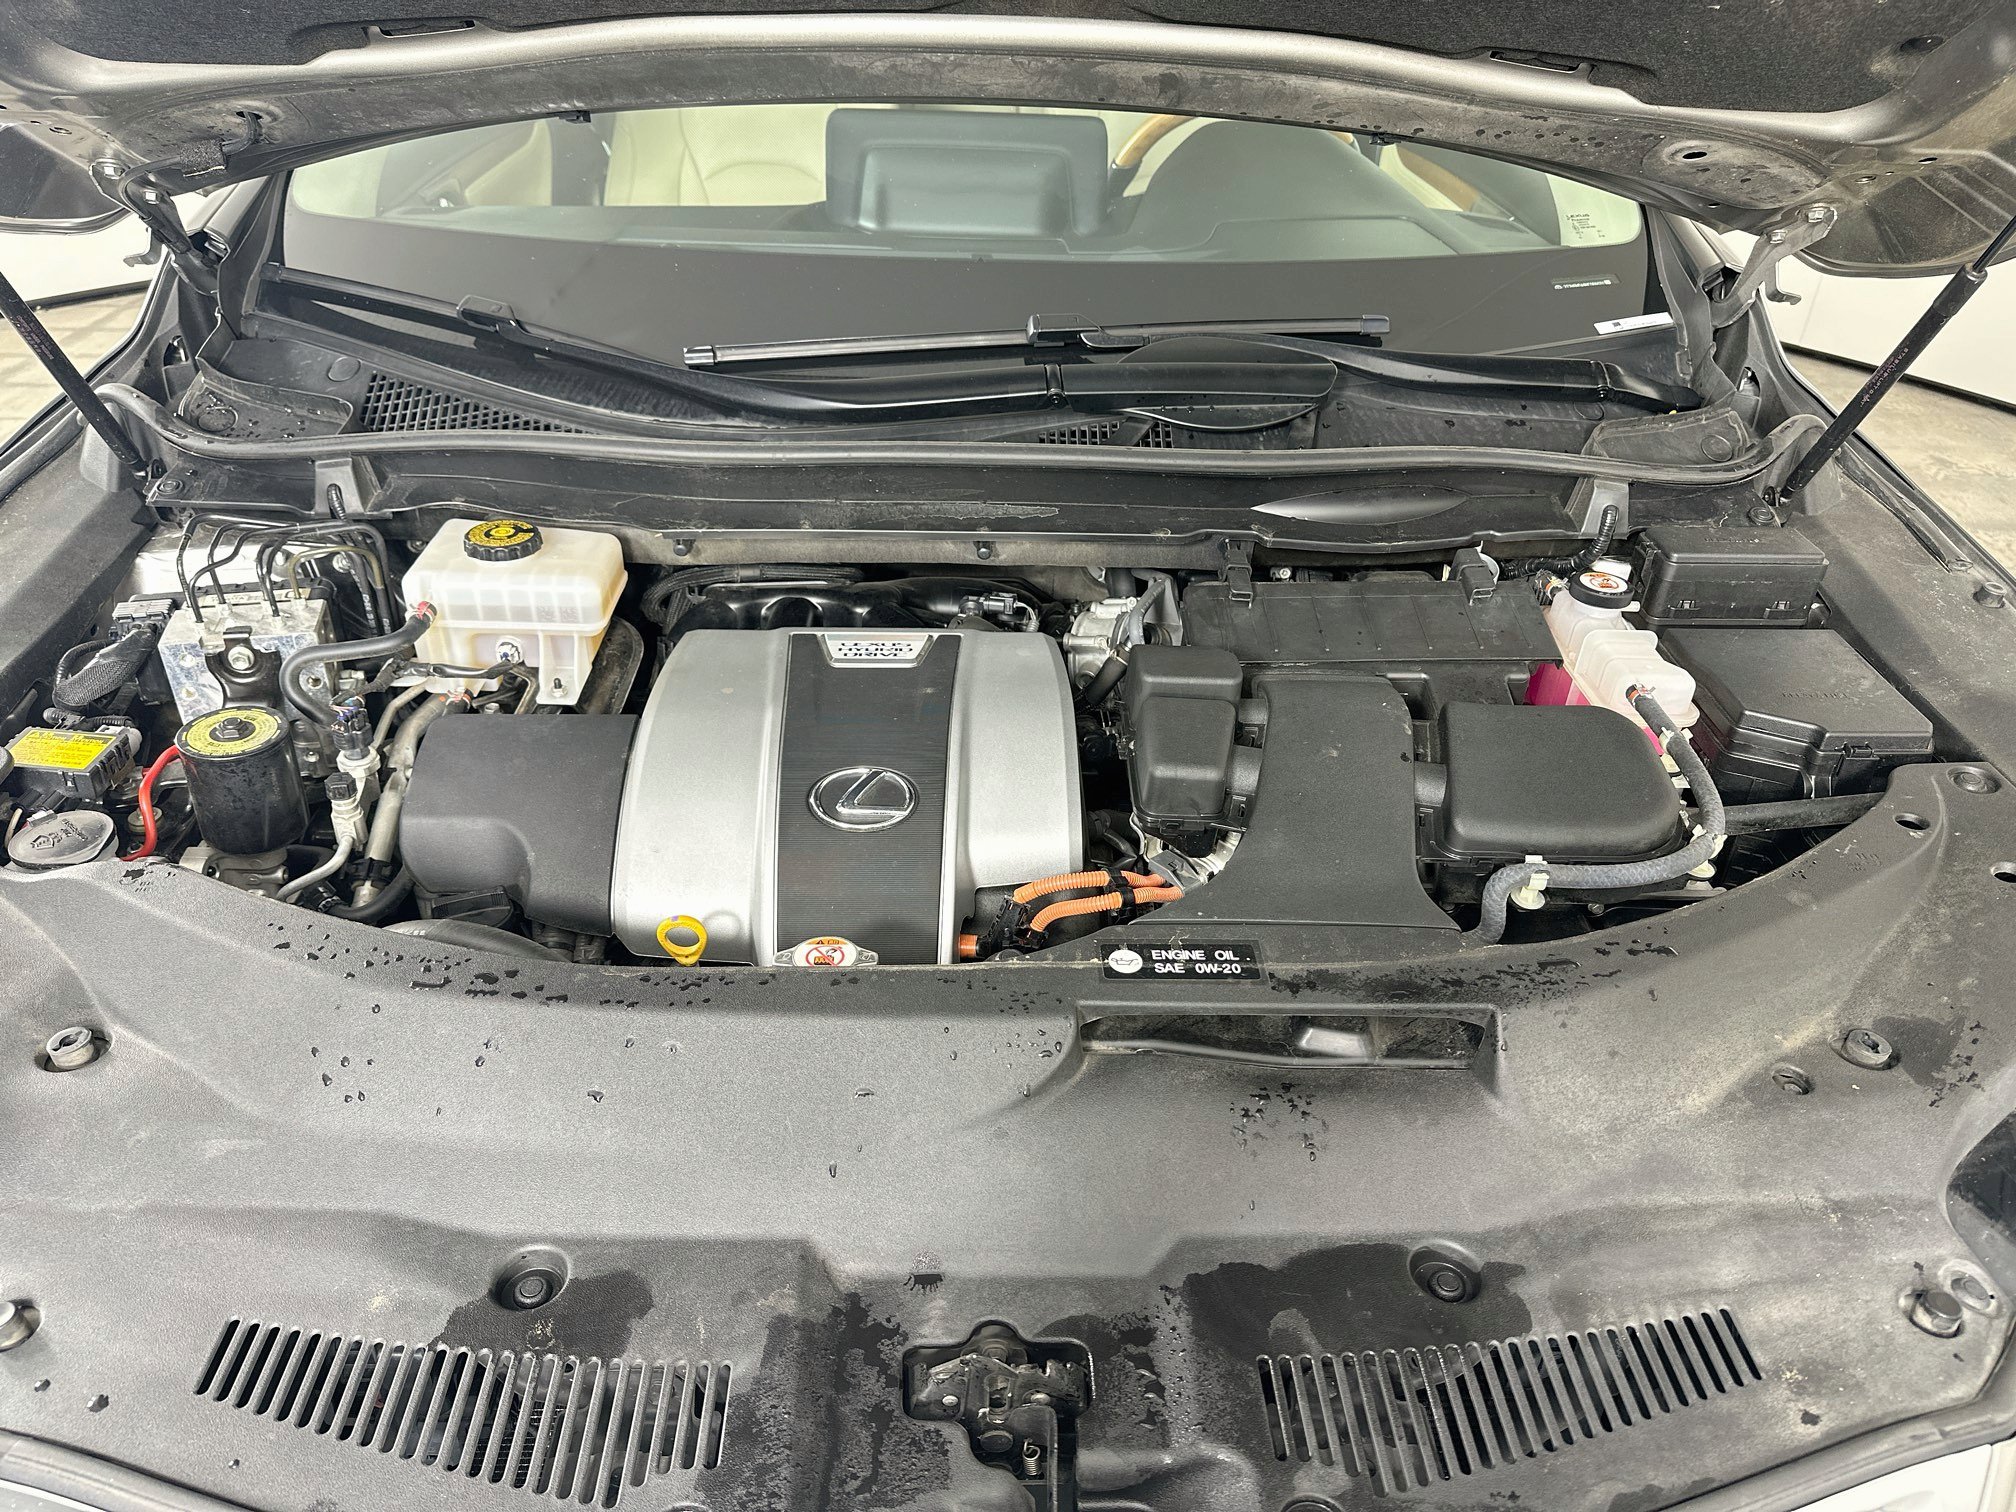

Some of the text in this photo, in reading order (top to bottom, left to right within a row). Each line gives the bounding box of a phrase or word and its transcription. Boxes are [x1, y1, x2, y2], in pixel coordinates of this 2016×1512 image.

[1151, 949, 1240, 961] ENGINE OIL
[1154, 962, 1242, 974] SAE 0W-20
